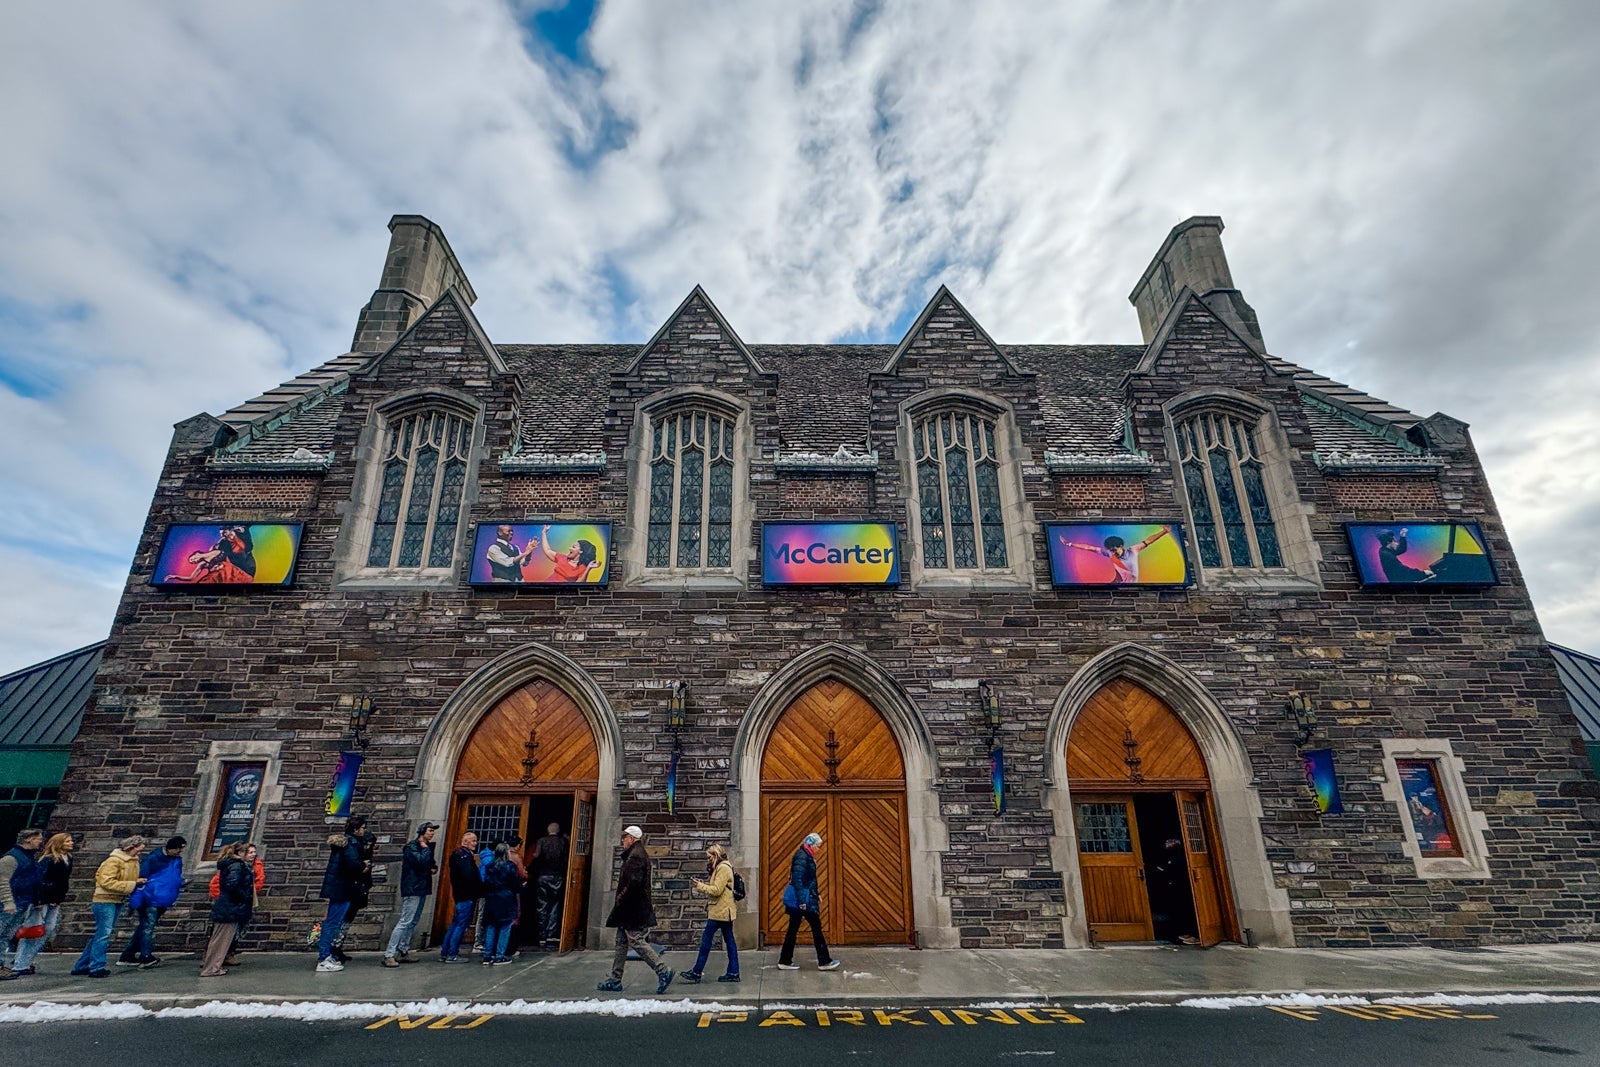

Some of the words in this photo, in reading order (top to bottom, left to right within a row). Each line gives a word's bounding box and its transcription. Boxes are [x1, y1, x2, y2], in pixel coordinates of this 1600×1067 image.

[767, 543, 894, 564] McCarter
[364, 1004, 495, 1030] NO
[697, 1008, 1085, 1028] PARKING
